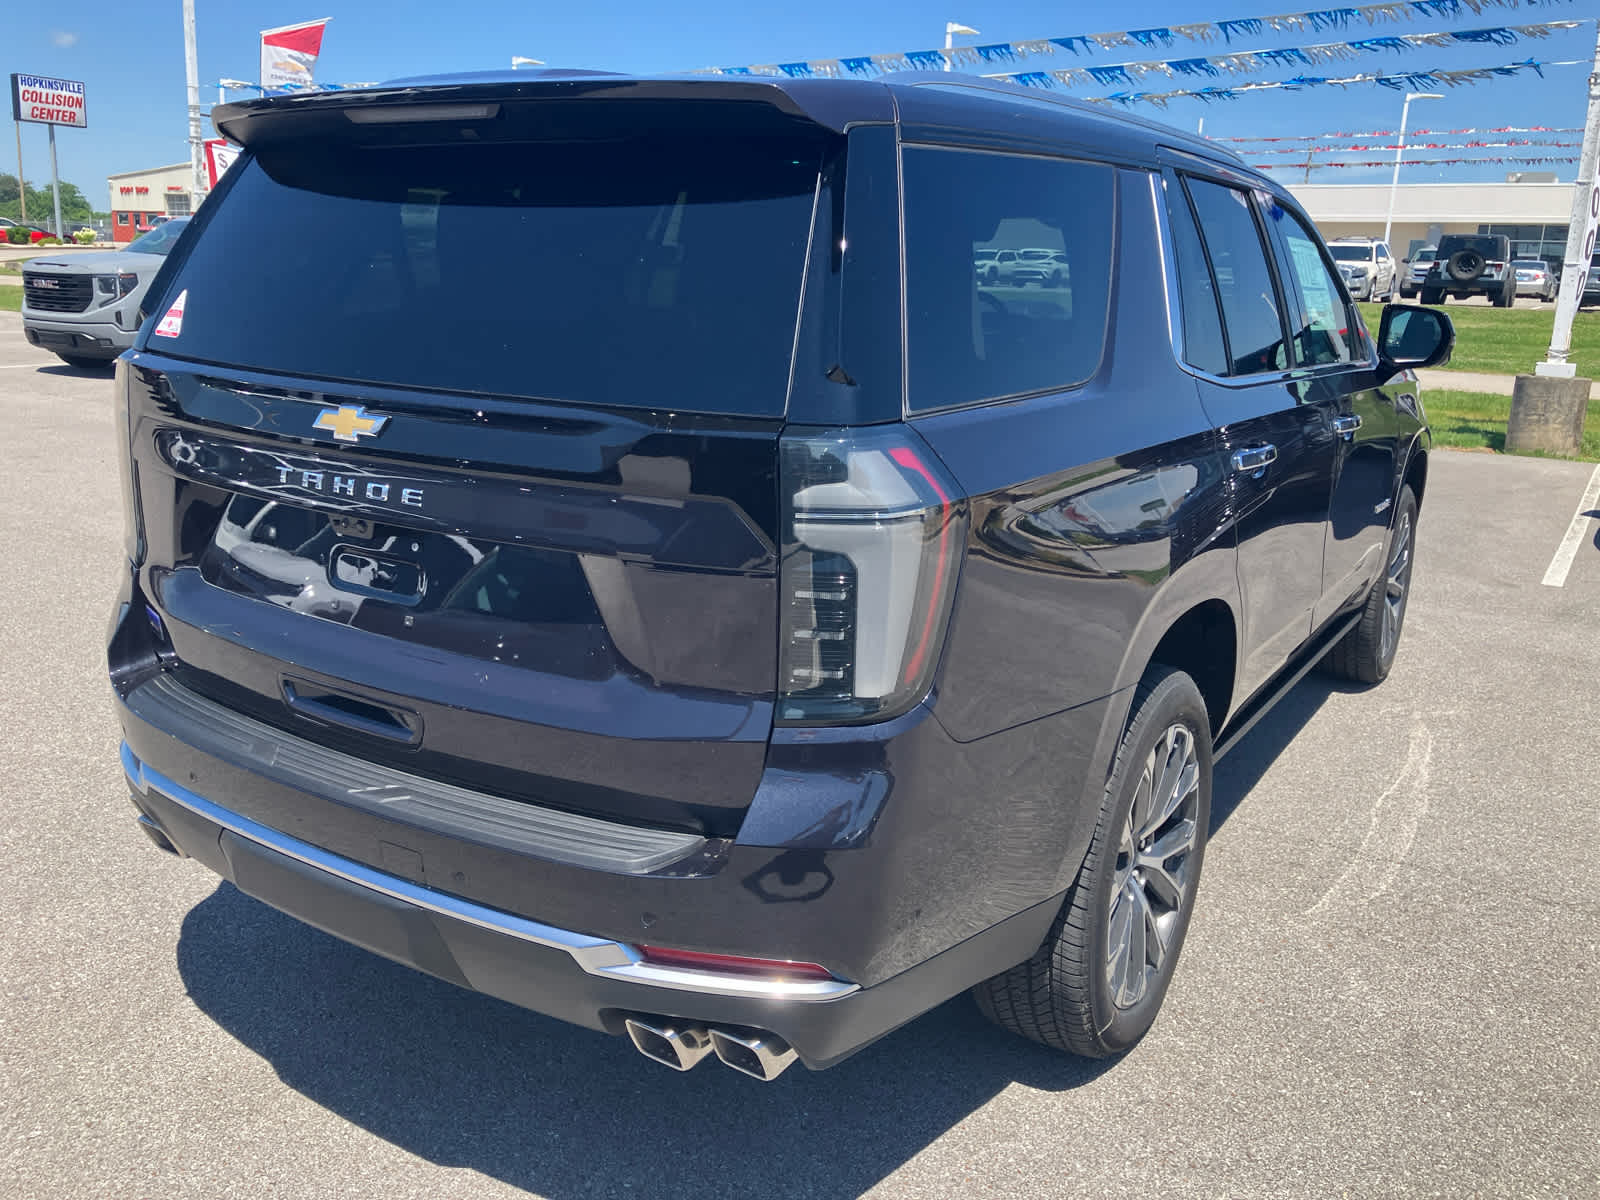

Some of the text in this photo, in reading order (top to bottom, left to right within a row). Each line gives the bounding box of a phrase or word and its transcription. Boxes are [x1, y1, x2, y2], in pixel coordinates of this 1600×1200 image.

[20, 76, 83, 94] HOPKINSVILLE
[22, 89, 83, 109] COLLISION
[31, 106, 76, 123] CENTER
[32, 279, 60, 288] GMC
[275, 466, 424, 508] TAHOE
